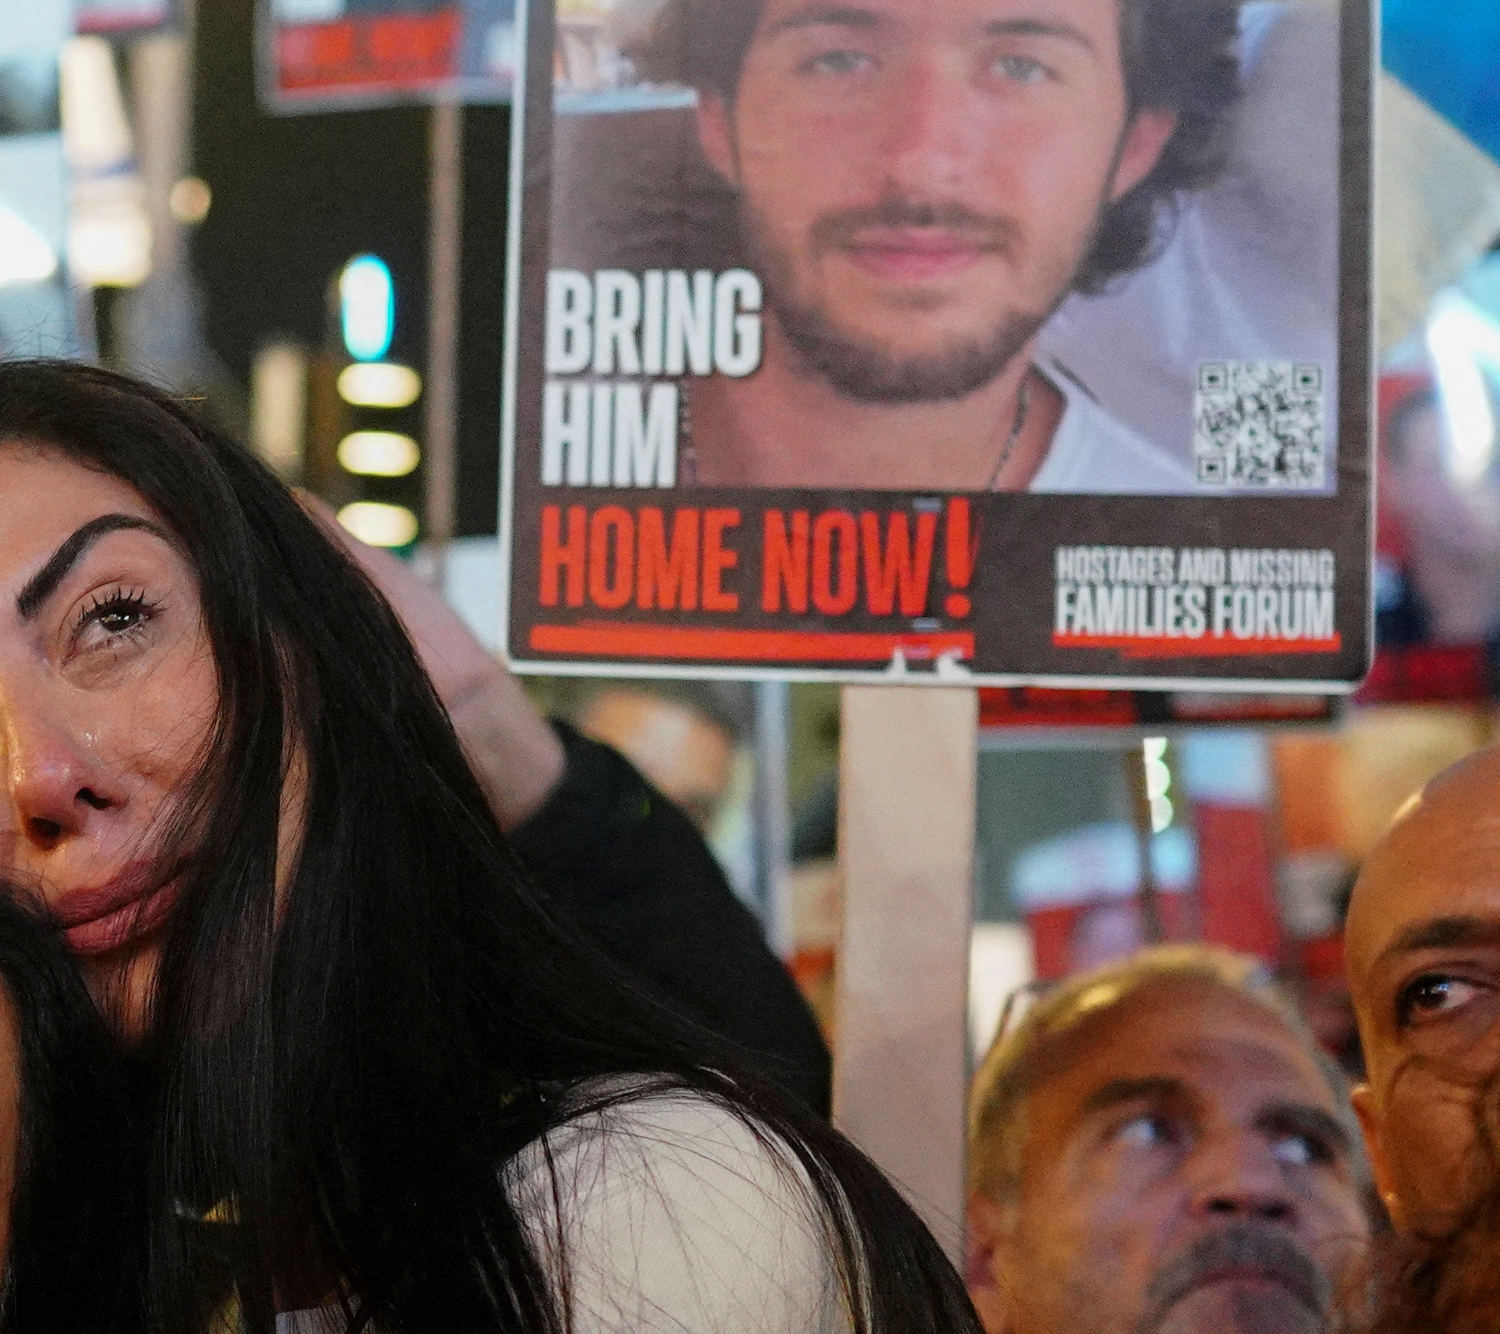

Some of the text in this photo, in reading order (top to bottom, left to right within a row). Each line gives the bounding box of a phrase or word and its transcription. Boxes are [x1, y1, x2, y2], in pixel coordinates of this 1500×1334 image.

[545, 266, 764, 378] BRING
[541, 380, 679, 489] HIM
[539, 496, 976, 619] HOME NOW!
[1055, 545, 1335, 587] HOSTAGES AND MISSING
[1055, 584, 1335, 640] FAMILIES FORUM
